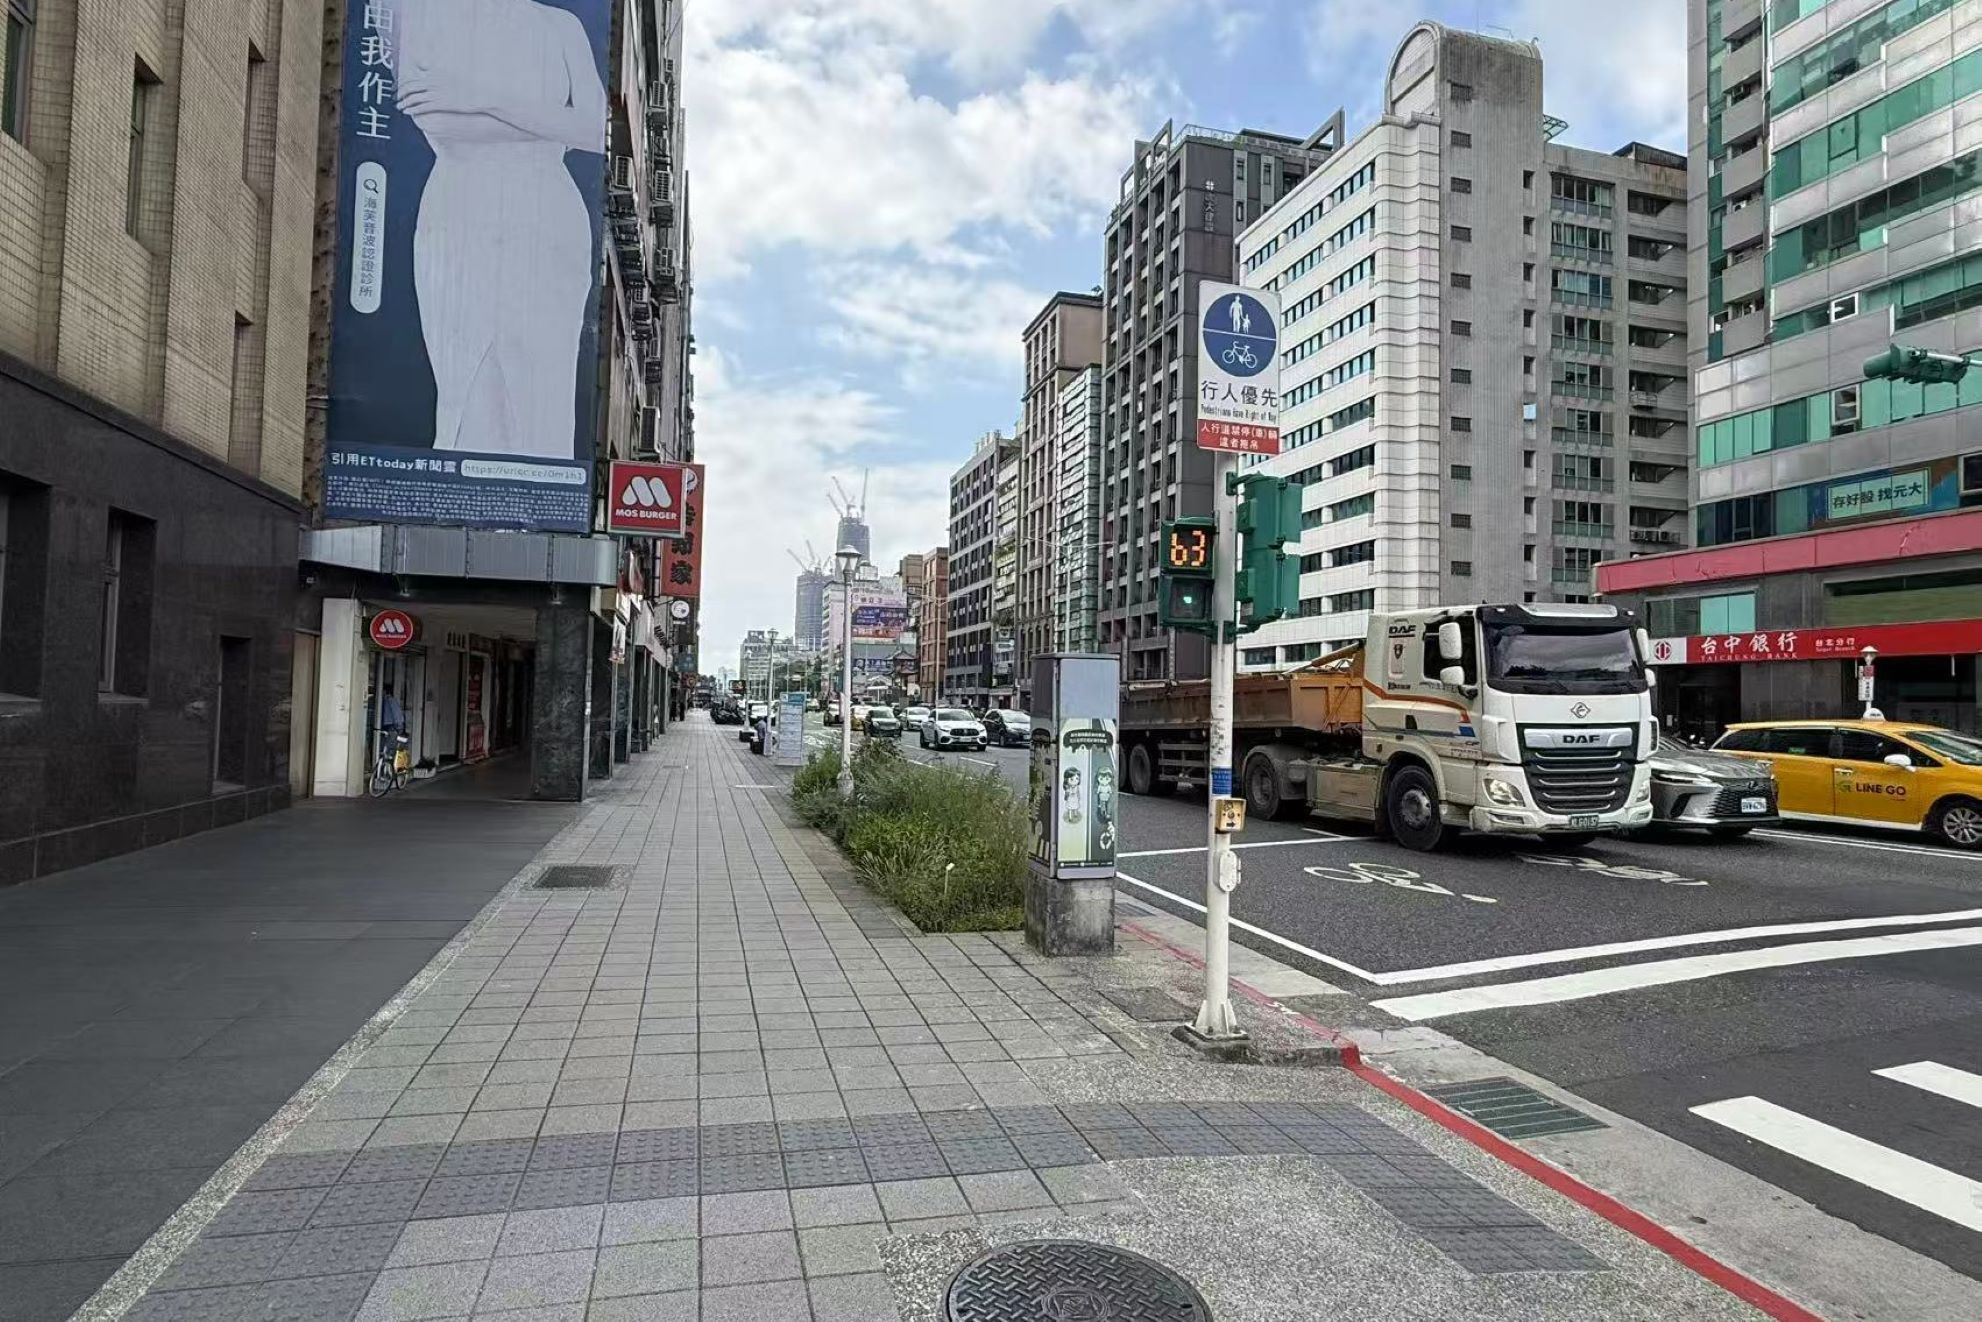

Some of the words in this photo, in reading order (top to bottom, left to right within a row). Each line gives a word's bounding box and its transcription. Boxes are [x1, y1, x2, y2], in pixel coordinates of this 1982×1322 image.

[1201, 380, 1278, 408] 行人優先
[1833, 490, 1874, 509] 存好股
[1878, 482, 1922, 502] 找元大
[615, 508, 639, 518] MOS
[639, 510, 677, 520] BURGER
[1170, 530, 1206, 566] 63
[1388, 624, 1416, 634] DAF
[1700, 632, 1798, 655] 台中銀行
[1701, 653, 1757, 662] TAICHUNG
[1766, 652, 1798, 660] BANK
[1562, 735, 1601, 744] DAF
[1856, 782, 1882, 794] LINE
[1885, 785, 1906, 796] GO
